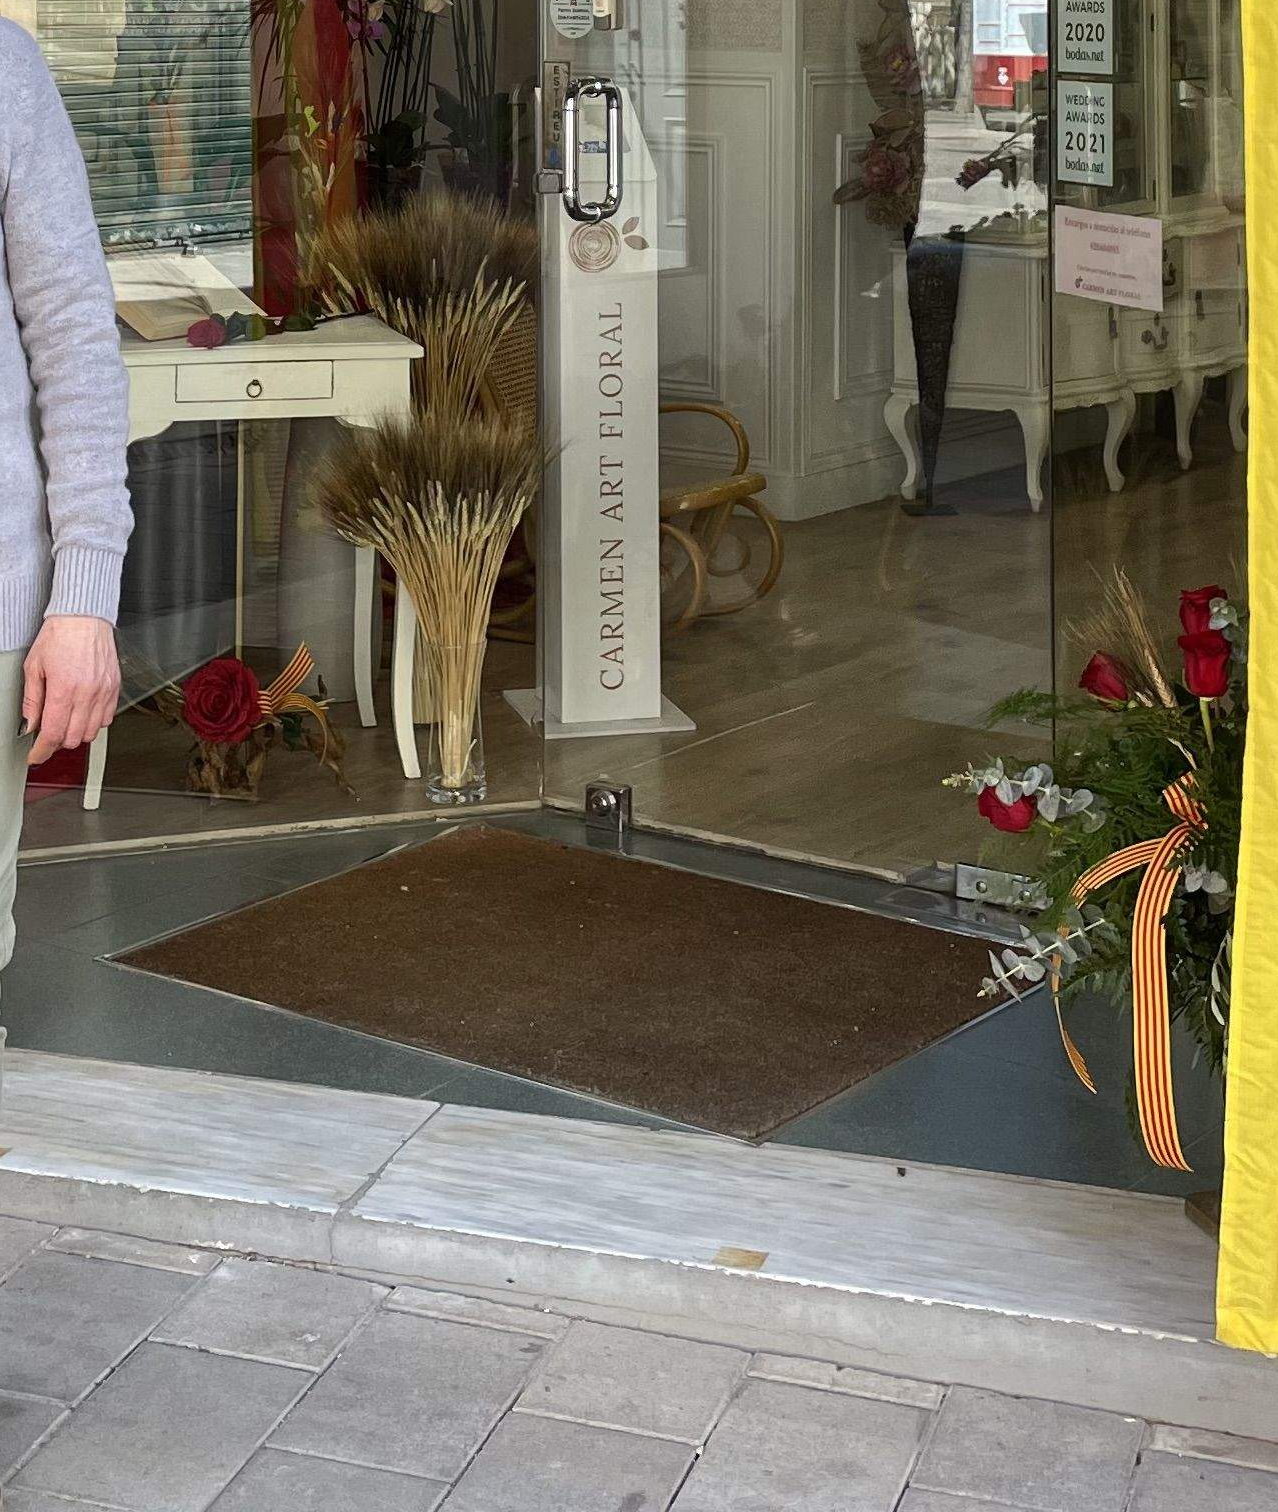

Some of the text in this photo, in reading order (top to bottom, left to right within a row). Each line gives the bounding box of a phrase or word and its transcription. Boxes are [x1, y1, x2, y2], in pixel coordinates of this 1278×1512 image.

[1065, 0, 1105, 13] AWARDS
[1065, 22, 1105, 42] 2020
[1065, 46, 1104, 62] bodas.net
[1065, 111, 1105, 125] AWARDS
[1065, 131, 1105, 154] 2021
[598, 301, 624, 691] CARMEN ART FLORAL
